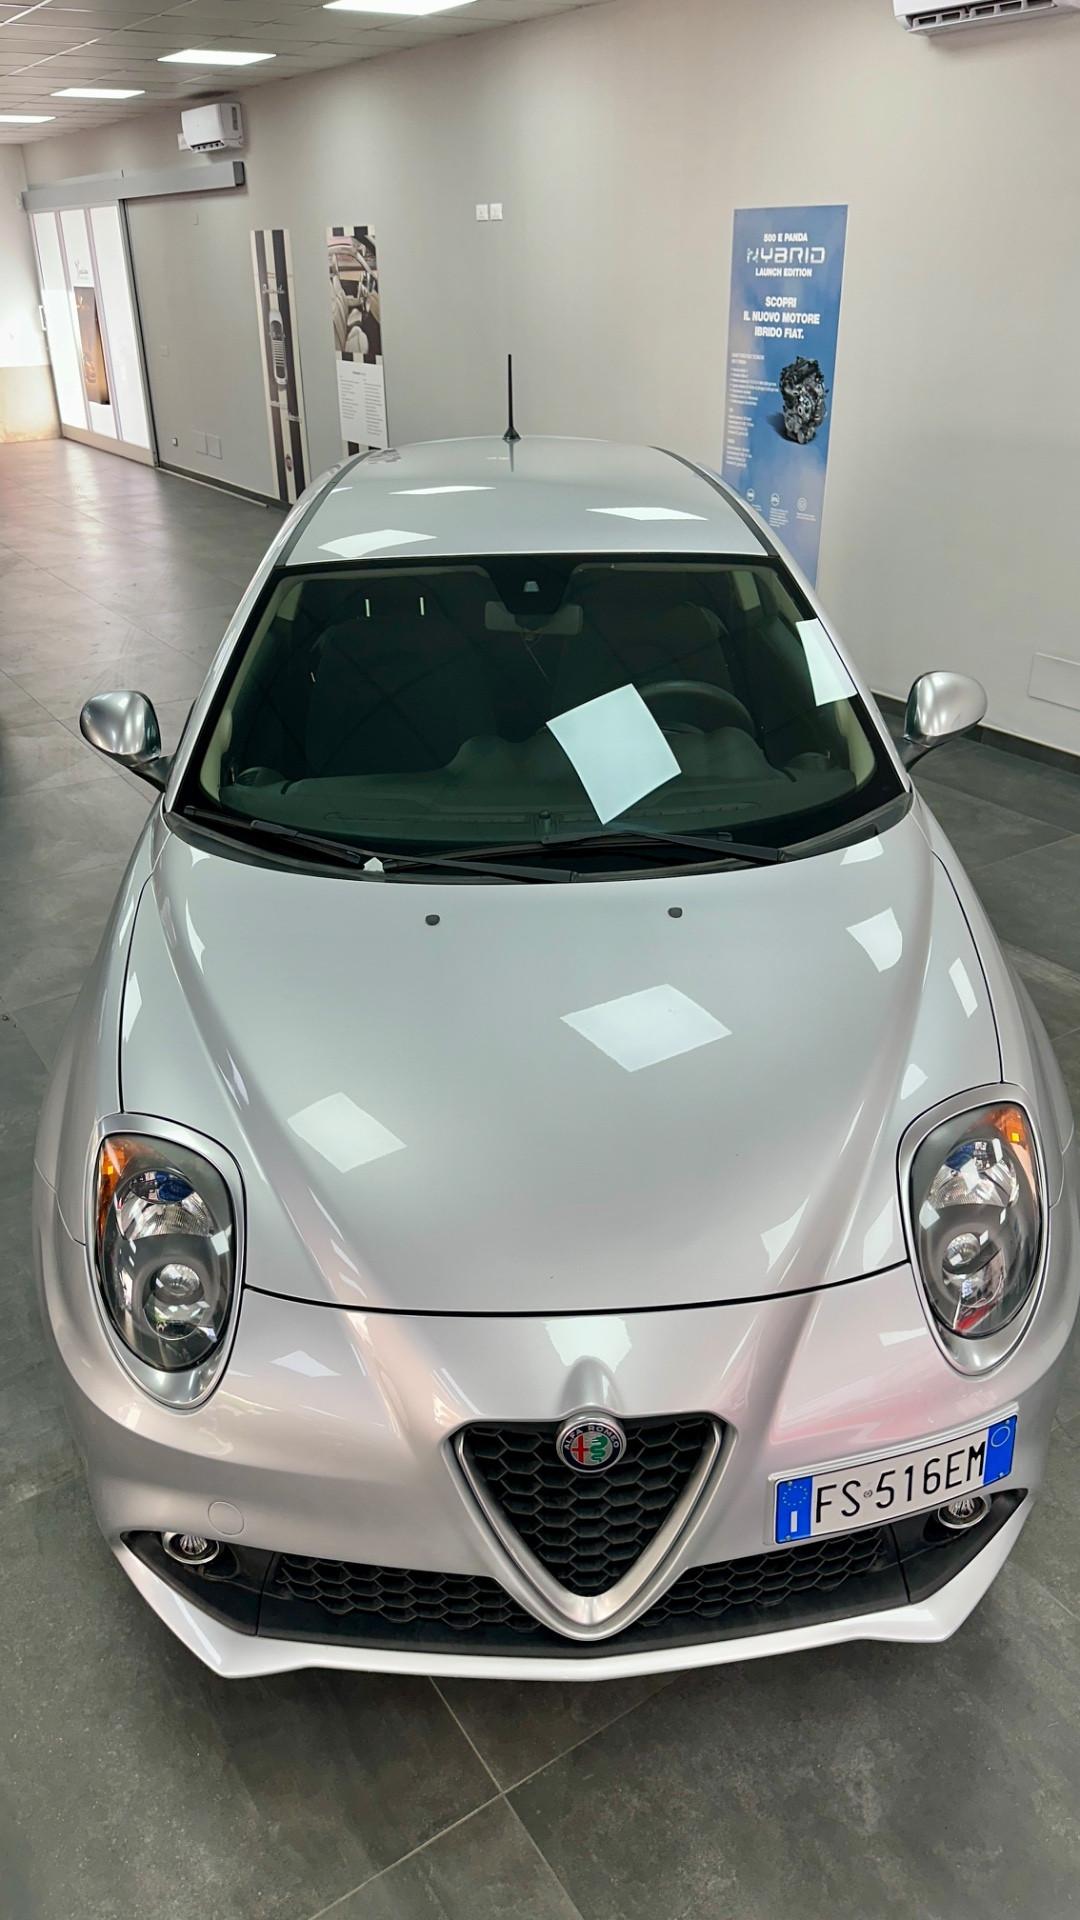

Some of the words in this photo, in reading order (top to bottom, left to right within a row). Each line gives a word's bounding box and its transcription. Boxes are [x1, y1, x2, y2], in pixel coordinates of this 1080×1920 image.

[763, 233, 776, 243] 500
[777, 233, 783, 242] E
[784, 232, 808, 242] PANDA
[746, 246, 826, 264] HYBRID
[755, 267, 783, 277] LAUNCH
[783, 267, 813, 277] EDITION
[765, 296, 797, 308] SCOPRI
[743, 310, 750, 321] IL
[752, 311, 780, 323] NUOVO
[782, 312, 820, 325] MOTORE
[754, 326, 782, 338] IBRIDO
[783, 327, 805, 340] FIAT.
[563, 1428, 584, 1451] ALFA
[587, 1425, 620, 1449] ROMEO
[790, 1511, 798, 1533] I
